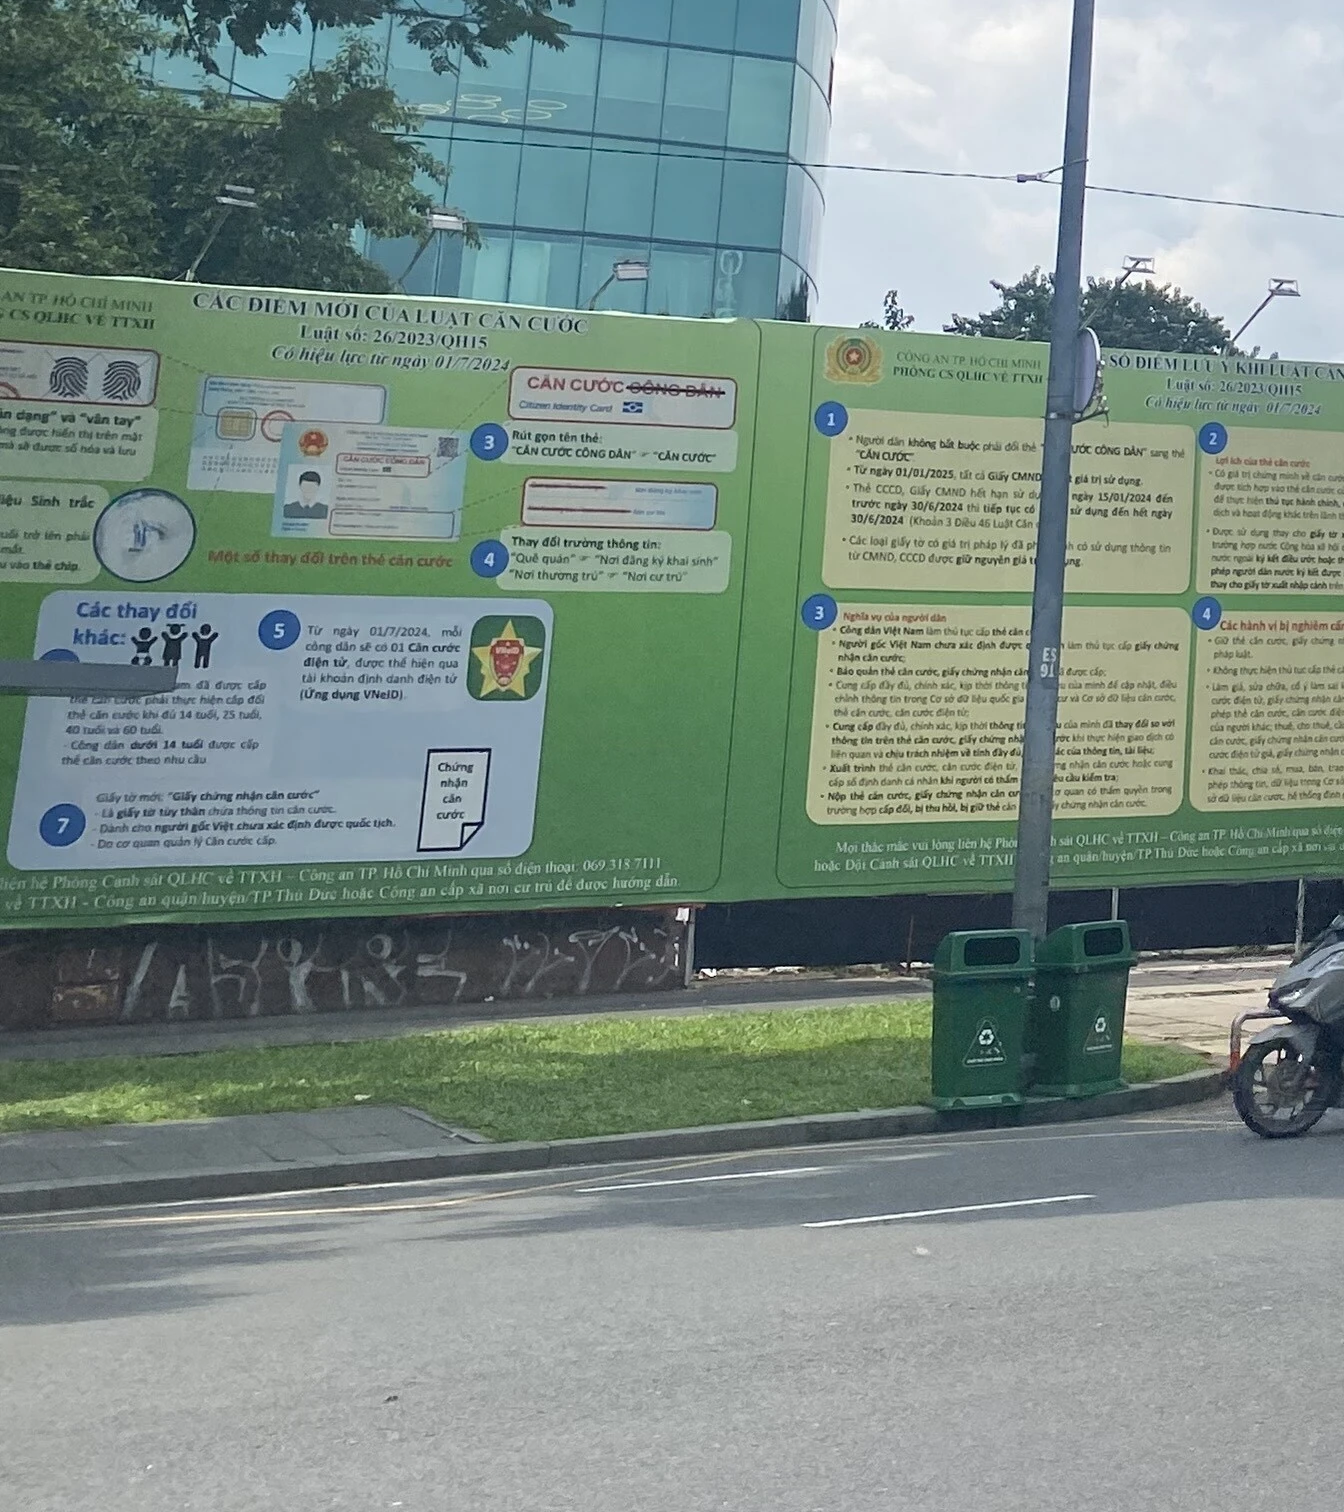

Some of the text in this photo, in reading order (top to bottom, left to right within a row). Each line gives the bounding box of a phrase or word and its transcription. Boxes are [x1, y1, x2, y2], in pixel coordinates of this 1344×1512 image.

[110, 299, 153, 312] MINH
[192, 292, 242, 311] CÁC
[314, 299, 359, 320] MỚI
[416, 308, 472, 329] LUẬT
[478, 310, 521, 331] CĂN
[9, 309, 31, 320] CS
[111, 317, 155, 330] TTXH
[300, 324, 341, 342] Luật
[372, 329, 488, 351] 26/2023/QH15
[271, 345, 296, 361] Có
[299, 347, 334, 363] hiệu
[394, 353, 430, 371] ngày
[434, 355, 510, 373] 01/7/2024
[897, 349, 930, 364] CÔNG
[934, 354, 949, 364] AN
[1011, 359, 1041, 370] MINH
[939, 369, 954, 380] CS
[956, 371, 993, 383] QLHC
[1012, 373, 1044, 384] TTXH
[1236, 360, 1264, 375] KHI
[1269, 361, 1311, 379] LUẬT
[827, 413, 836, 427] 1
[484, 435, 495, 450] 3
[512, 430, 532, 440] Rút
[535, 431, 556, 444] gọn
[559, 433, 578, 443] tên
[1209, 432, 1217, 445] 2
[853, 465, 867, 476] Từ
[869, 467, 893, 478] ngày
[31, 495, 60, 507] Sinh
[850, 513, 904, 526] 30/6/2024
[512, 536, 539, 548] Thay
[542, 535, 561, 547] đổi
[563, 538, 603, 551] trường
[607, 538, 640, 551] thông
[483, 553, 495, 567] 4
[76, 601, 197, 622] Các thay đổi
[814, 605, 824, 620] 3
[1202, 607, 1211, 620] 4
[273, 623, 284, 639] 5
[307, 625, 323, 637] Từ
[332, 628, 359, 639] ngày
[1220, 620, 1237, 631] Các
[1240, 620, 1266, 631] hành
[1268, 621, 1277, 631] vi
[1279, 620, 1290, 633] bị
[1291, 620, 1329, 633] nghiêm
[72, 628, 125, 646] khác:
[1042, 647, 1057, 662] ES
[1040, 664, 1056, 678] 91
[331, 690, 360, 701] dụng
[437, 762, 474, 774] Chứng
[440, 778, 468, 789] nhận
[442, 794, 462, 804] căn
[436, 808, 465, 820] cước
[56, 818, 70, 835] 7
[433, 863, 468, 878] Minh
[470, 865, 494, 880] qua
